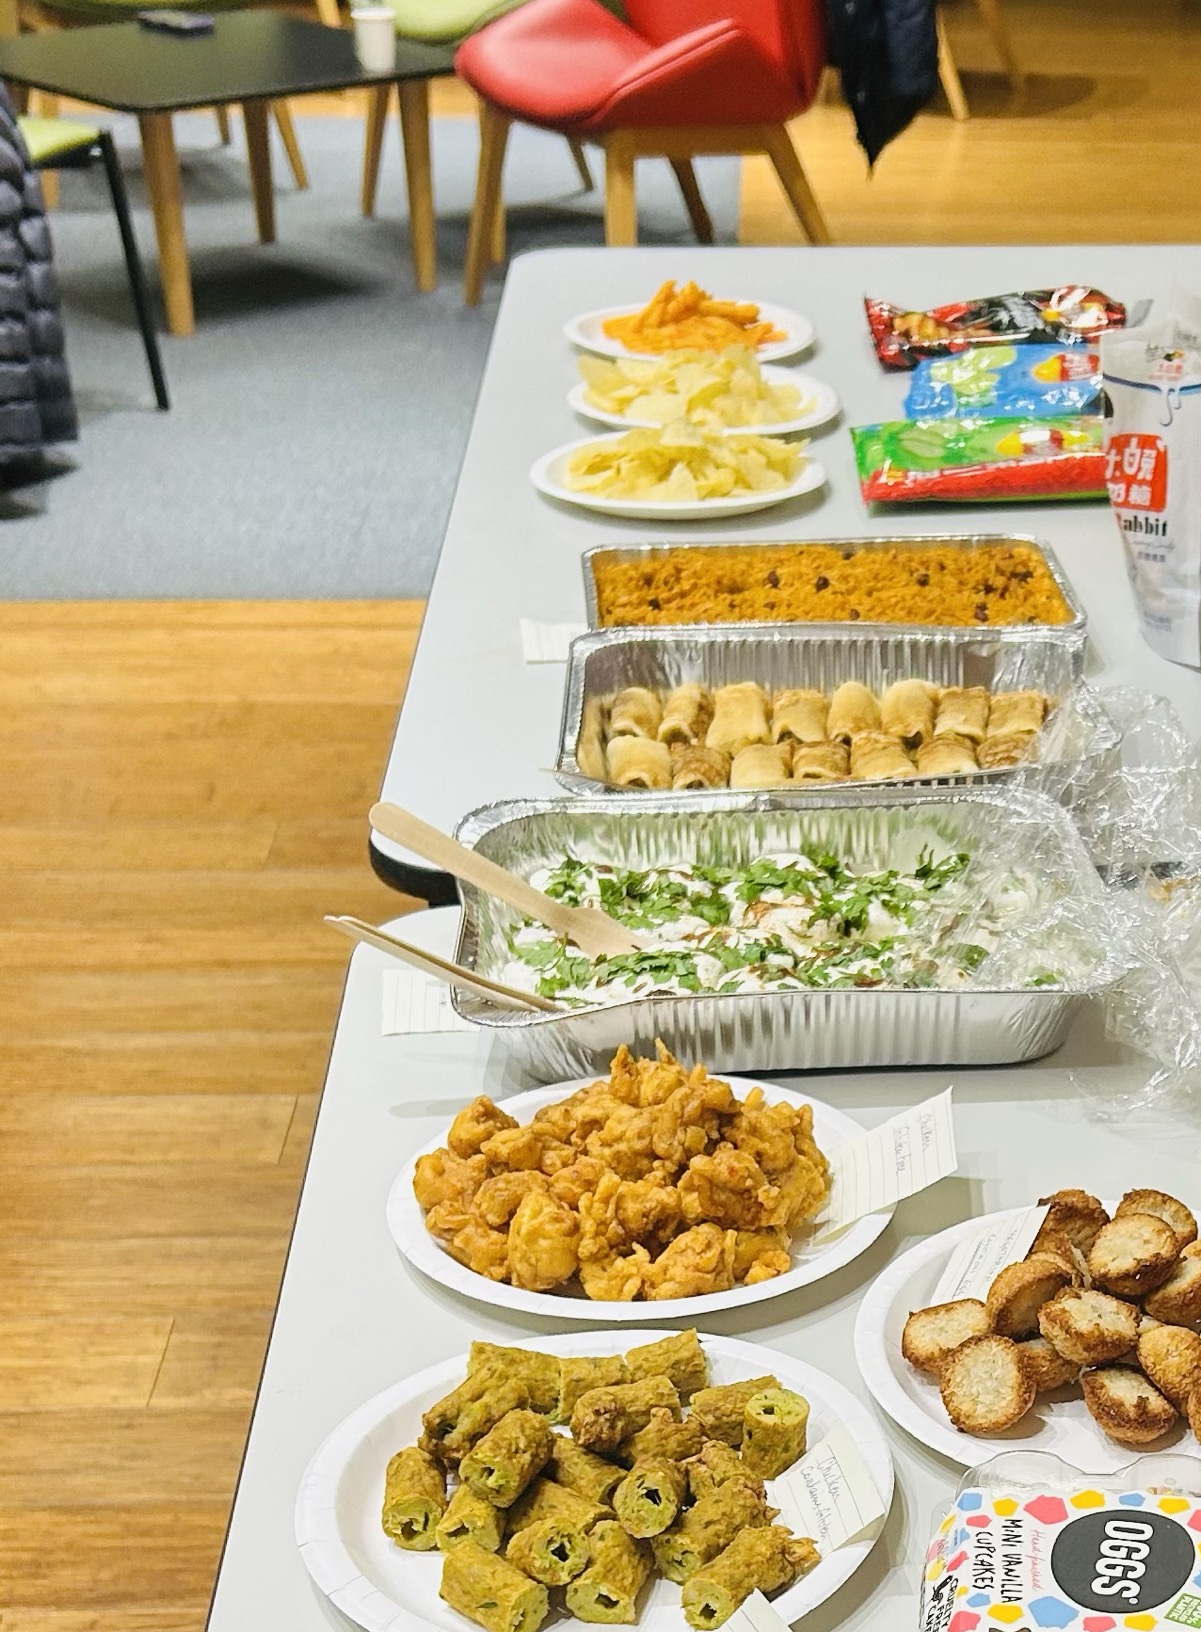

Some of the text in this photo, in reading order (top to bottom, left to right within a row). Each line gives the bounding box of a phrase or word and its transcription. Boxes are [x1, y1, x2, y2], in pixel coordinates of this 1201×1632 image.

[1121, 515, 1167, 536] abbit
[972, 1532, 996, 1589] CUPCAKES
[1090, 1520, 1154, 1598] OGGS
[941, 1578, 958, 1628] CRUELTY
[1169, 1596, 1193, 1620] PLASTIC
